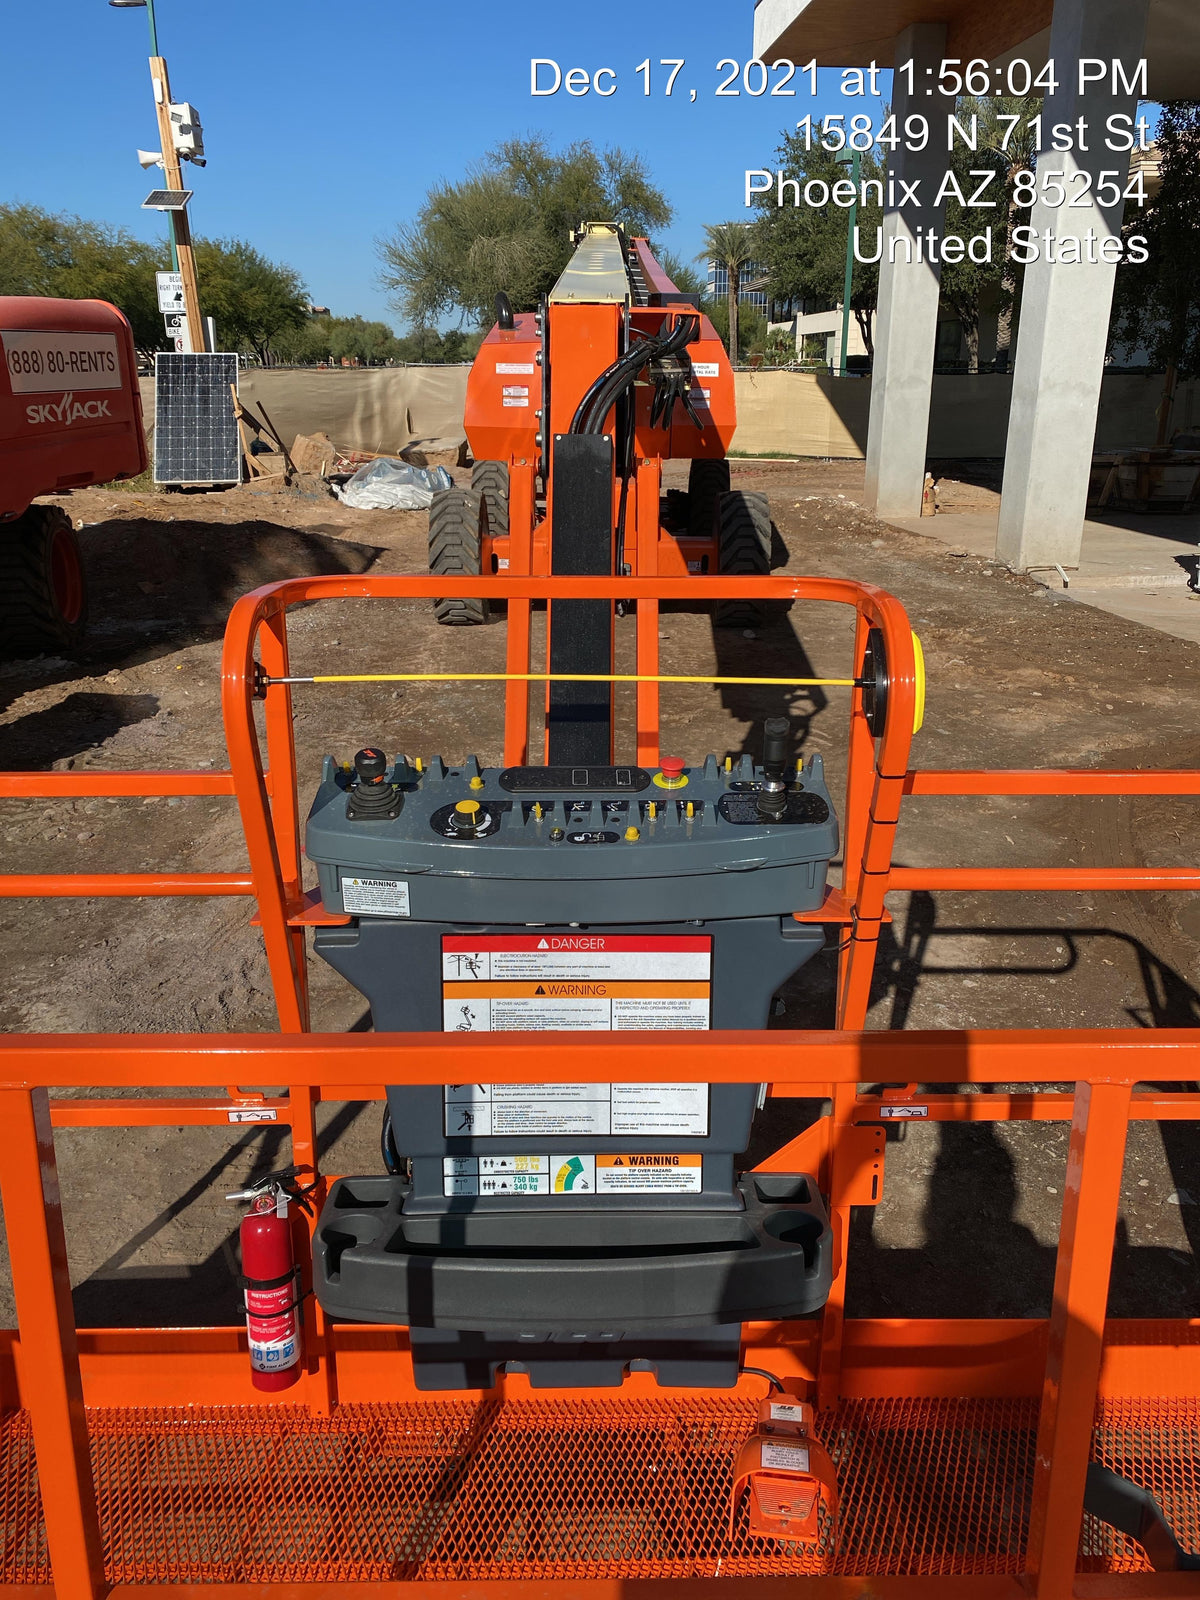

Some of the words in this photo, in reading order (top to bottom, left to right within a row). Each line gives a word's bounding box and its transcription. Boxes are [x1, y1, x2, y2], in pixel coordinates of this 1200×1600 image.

[7, 349, 43, 375] (888)
[47, 350, 115, 373] 80-RENTS
[26, 392, 112, 425] SKYJACK
[551, 938, 606, 949] DANGER
[548, 985, 607, 996] WARNING
[629, 1156, 679, 1165] WARNING
